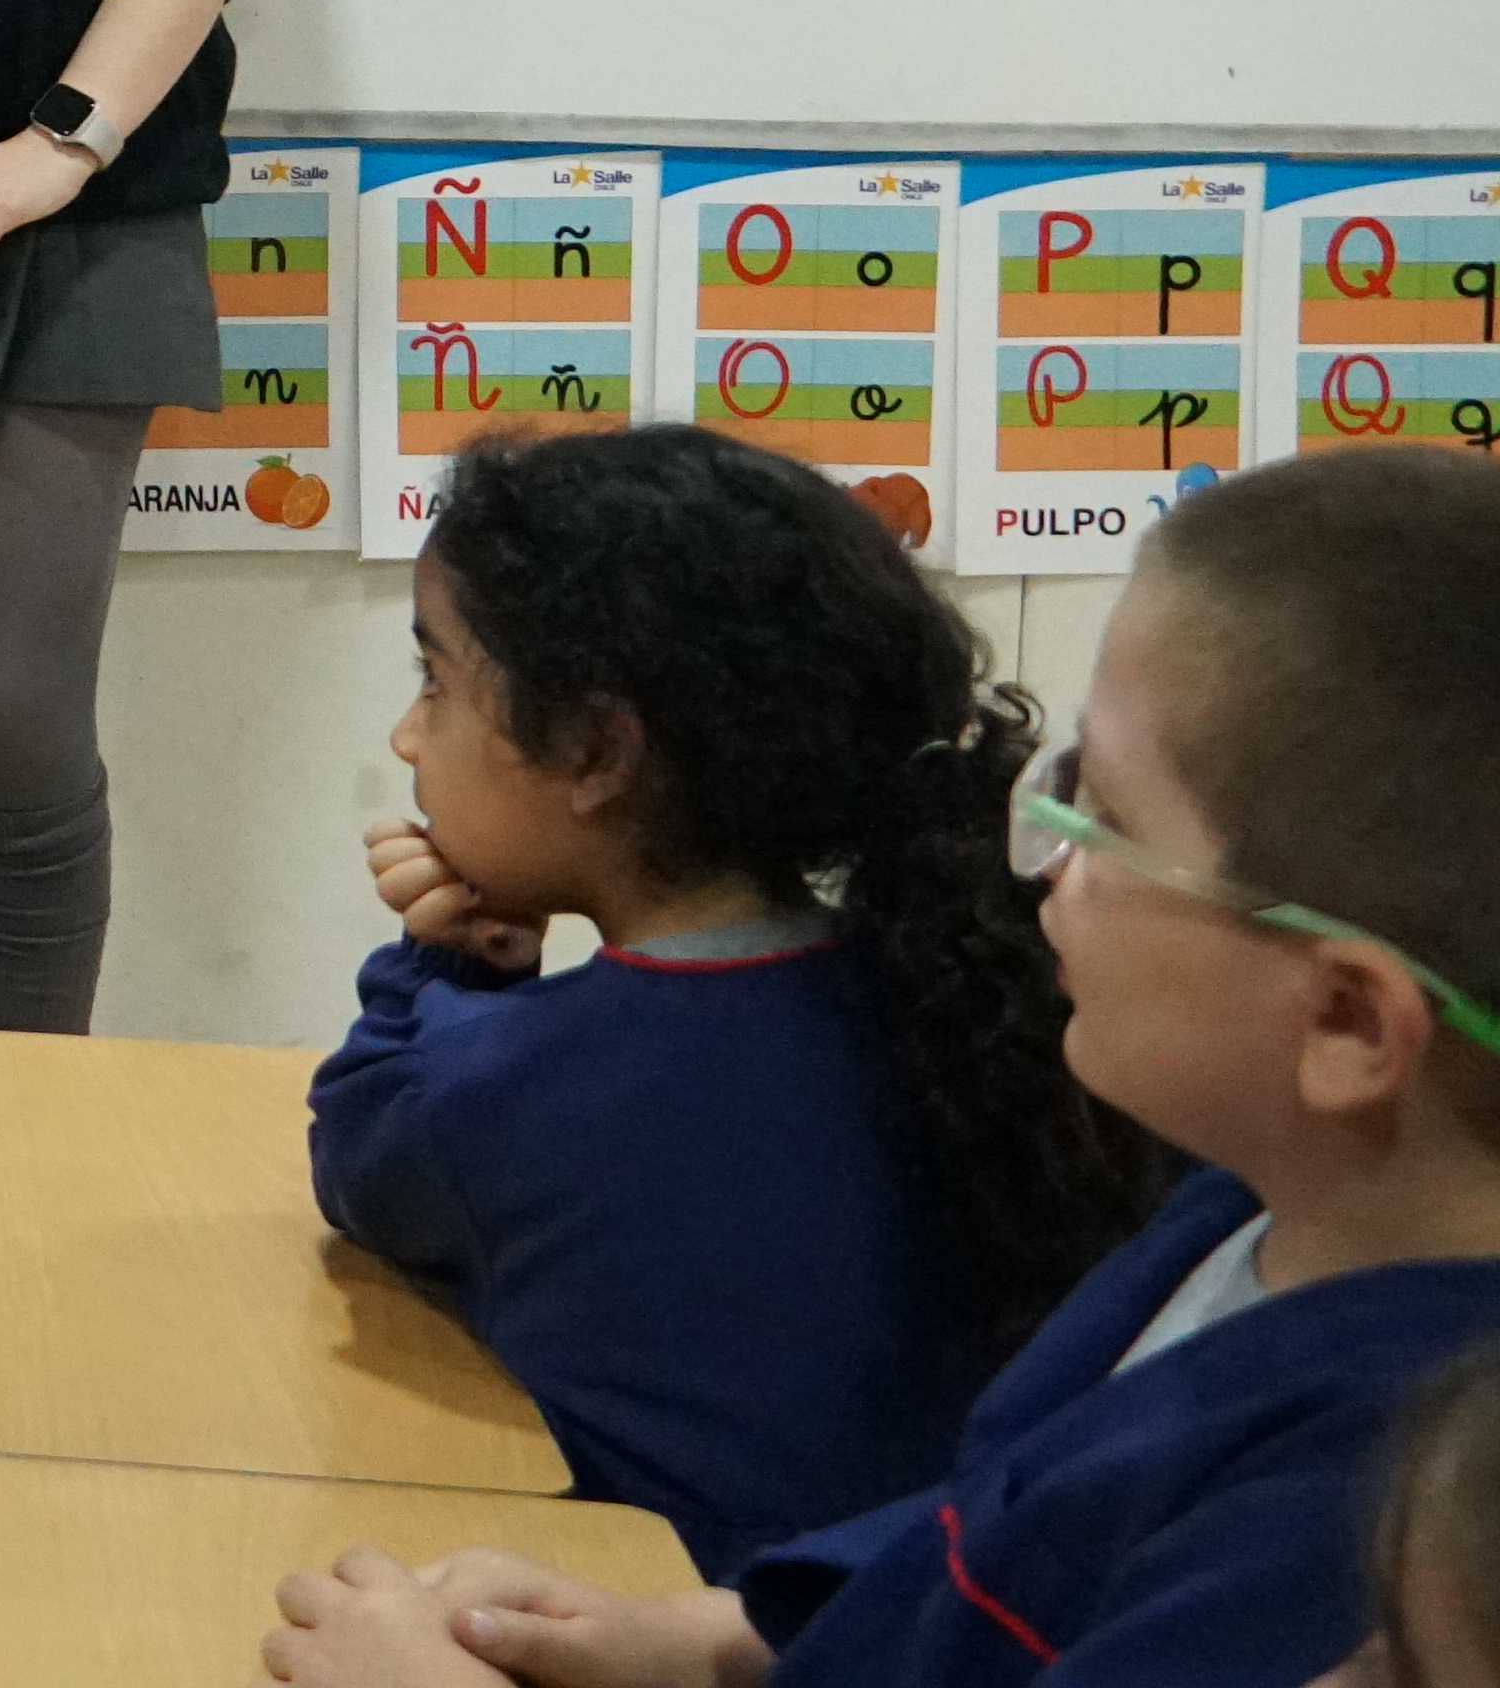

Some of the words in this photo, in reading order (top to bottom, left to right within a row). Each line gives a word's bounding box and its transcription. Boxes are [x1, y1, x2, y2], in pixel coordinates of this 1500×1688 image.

[251, 166, 269, 182] La
[290, 166, 329, 183] Salle
[552, 169, 571, 185] La
[593, 169, 632, 185] Salle
[859, 178, 877, 193] La
[900, 178, 941, 194] Salle
[1161, 182, 1181, 198] La
[1204, 182, 1245, 197] Salle
[425, 177, 488, 277] Ñ
[553, 224, 591, 279] ñ
[250, 236, 287, 273] n
[726, 203, 793, 286] O
[856, 251, 893, 287] o
[1038, 210, 1094, 294] P
[1158, 254, 1201, 335] p
[1326, 216, 1396, 299] Q
[1453, 261, 1495, 342] q
[995, 508, 1127, 537] PULPO
